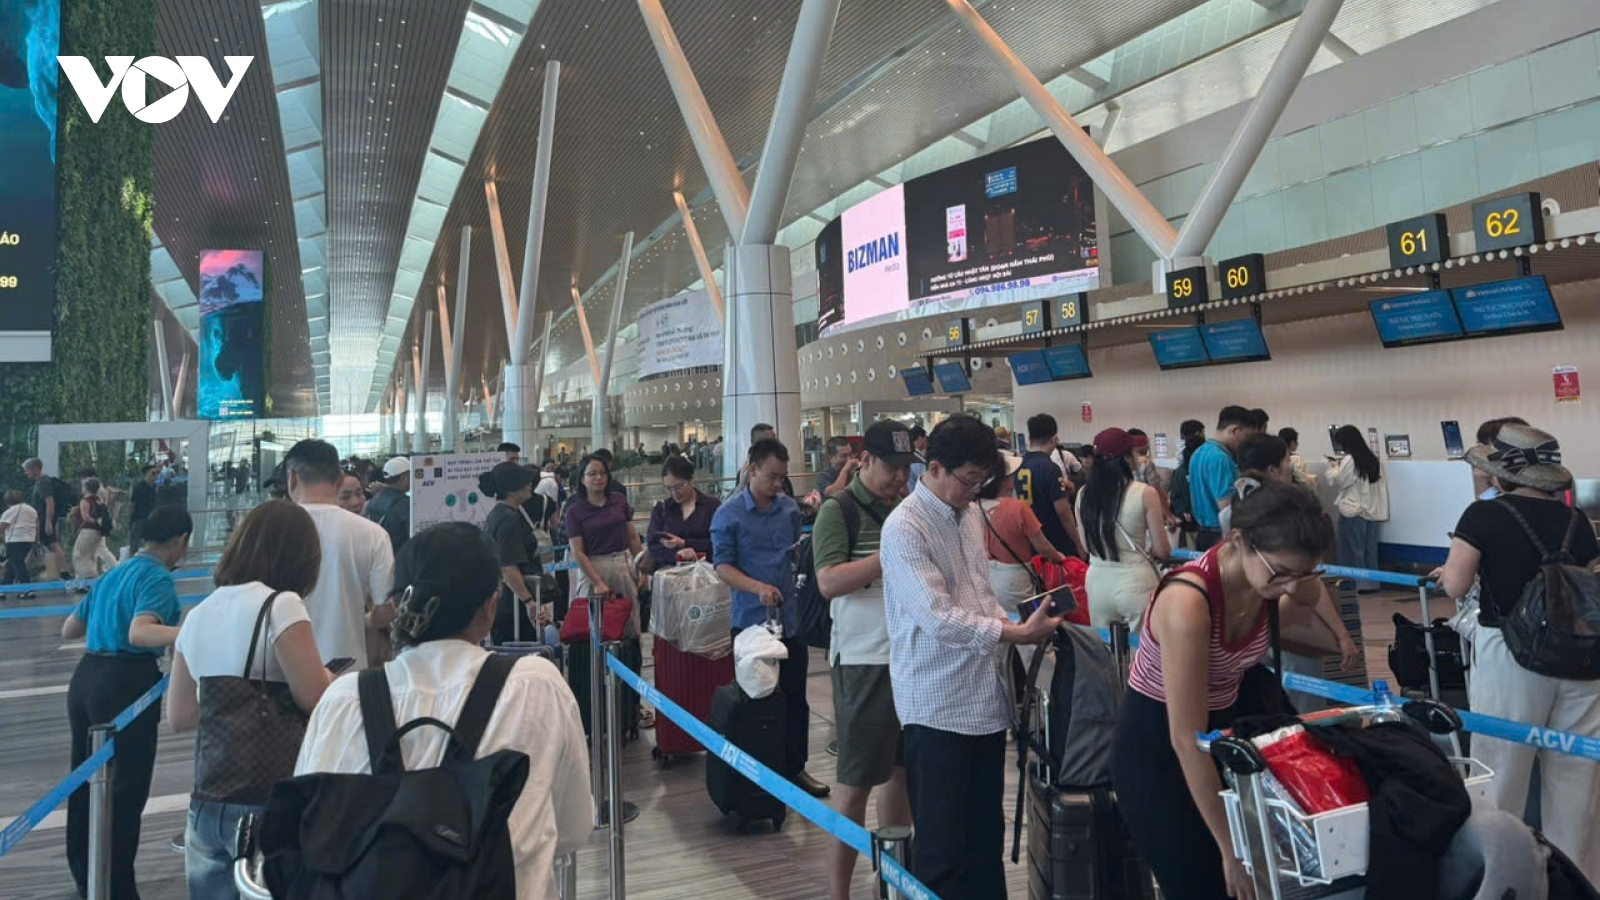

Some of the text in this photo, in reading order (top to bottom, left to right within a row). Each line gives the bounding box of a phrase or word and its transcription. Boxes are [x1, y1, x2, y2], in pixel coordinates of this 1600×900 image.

[1486, 208, 1520, 237] 62
[847, 231, 899, 273] BIZMAN
[1401, 228, 1427, 255] 61
[1173, 277, 1192, 298] 59
[1227, 266, 1248, 288] 60
[1025, 309, 1038, 326] 57
[1061, 301, 1075, 318] 58
[1525, 726, 1576, 752] ACV
